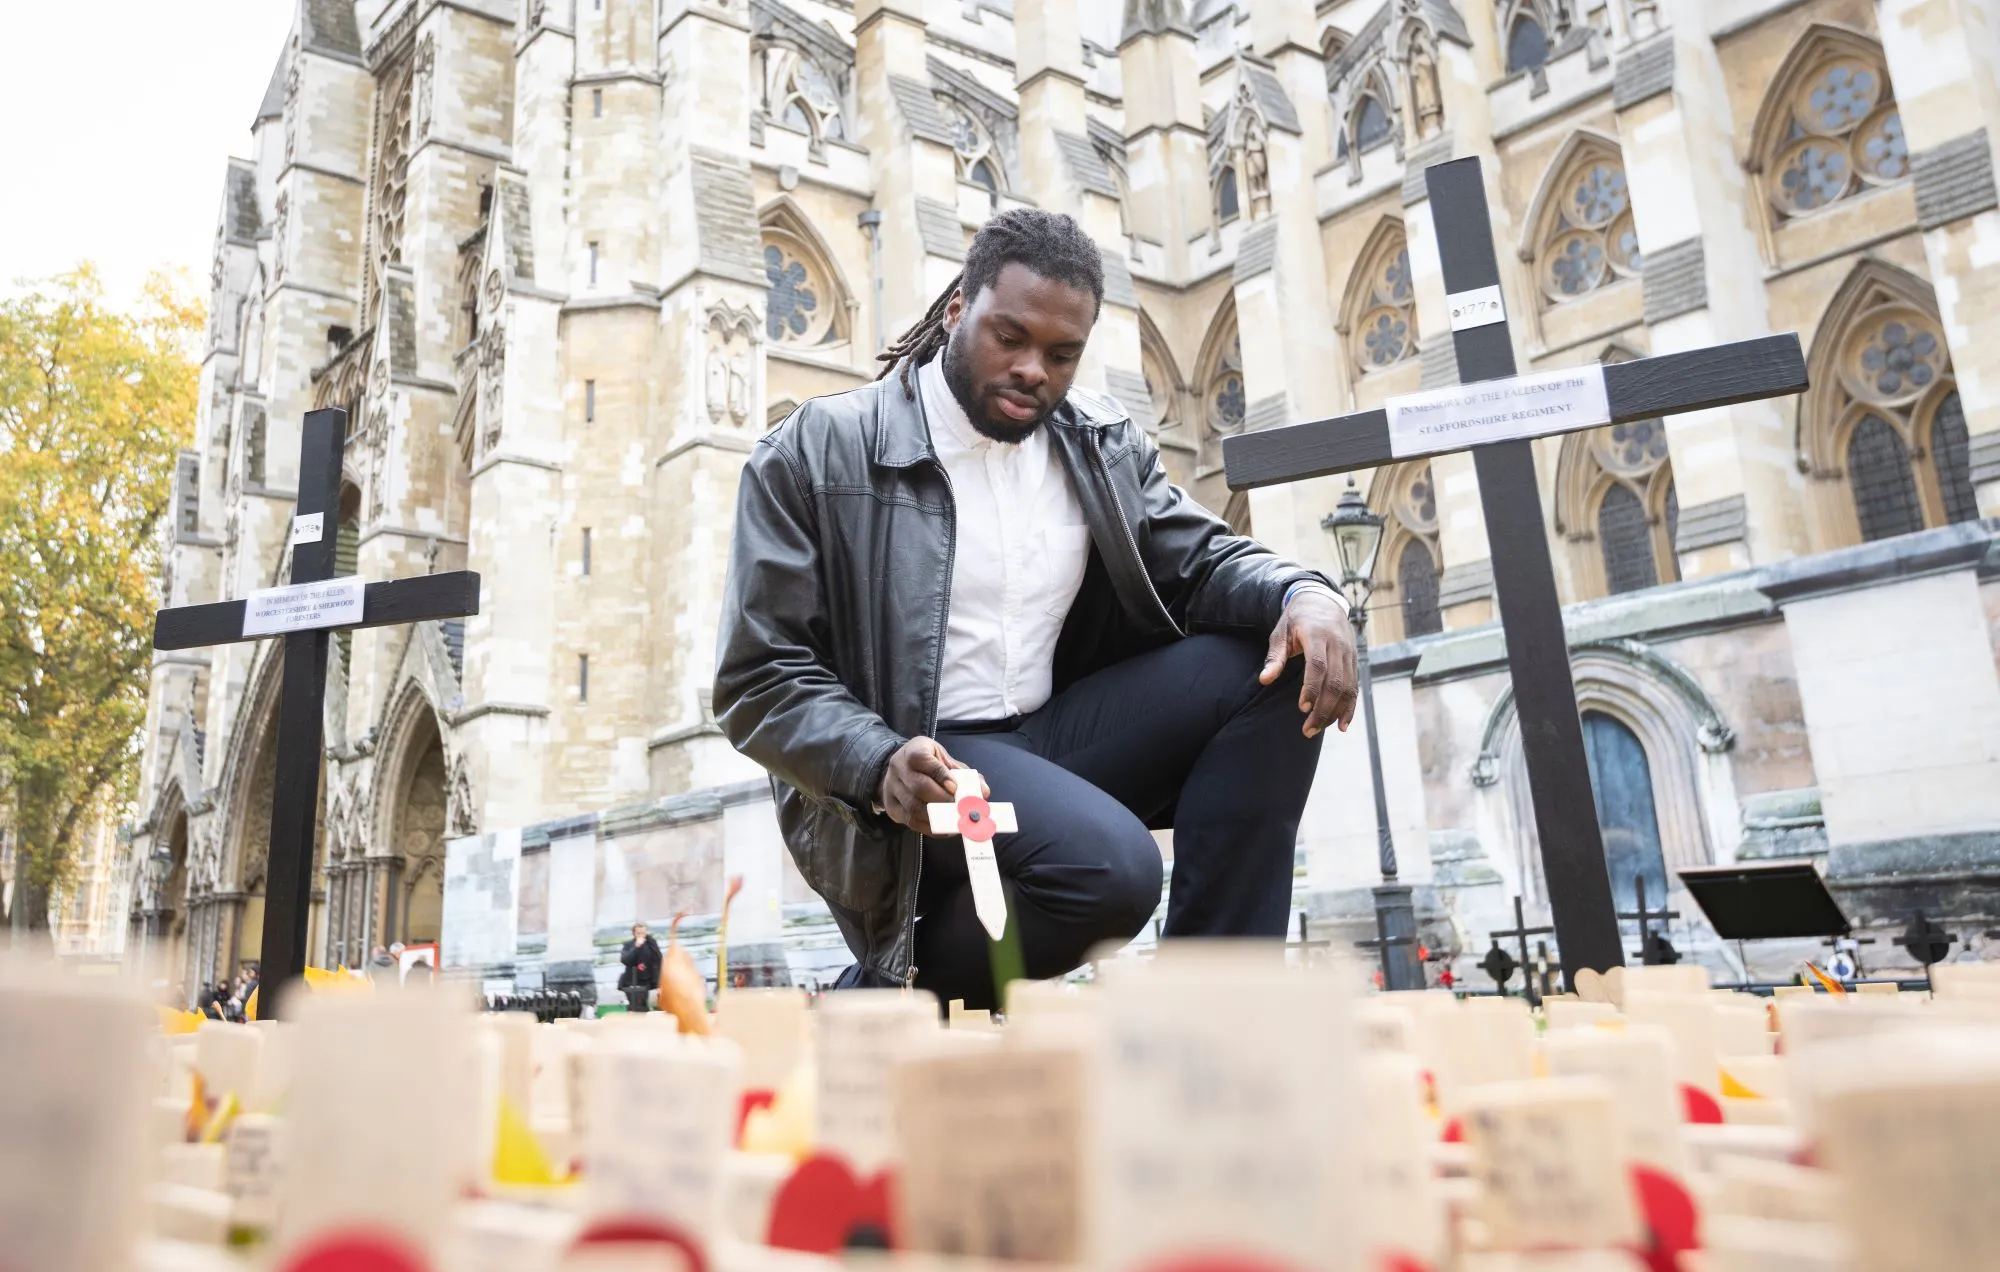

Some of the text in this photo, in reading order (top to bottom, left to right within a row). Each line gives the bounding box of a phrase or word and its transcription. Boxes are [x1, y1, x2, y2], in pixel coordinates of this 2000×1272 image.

[1400, 405, 1413, 415] IN
[1464, 395, 1479, 406] OF
[1481, 391, 1501, 402] THE
[1504, 384, 1546, 398] FALLEN
[1547, 382, 1562, 392] OF
[1566, 378, 1587, 388] THE
[1418, 415, 1509, 435] STAFFORDSHIRE
[274, 595, 299, 604] MEMORY
[310, 592, 321, 600] THE
[322, 588, 346, 598] FALLEN
[318, 599, 355, 609] SHERWOOD
[286, 612, 321, 623] FORESTERS
